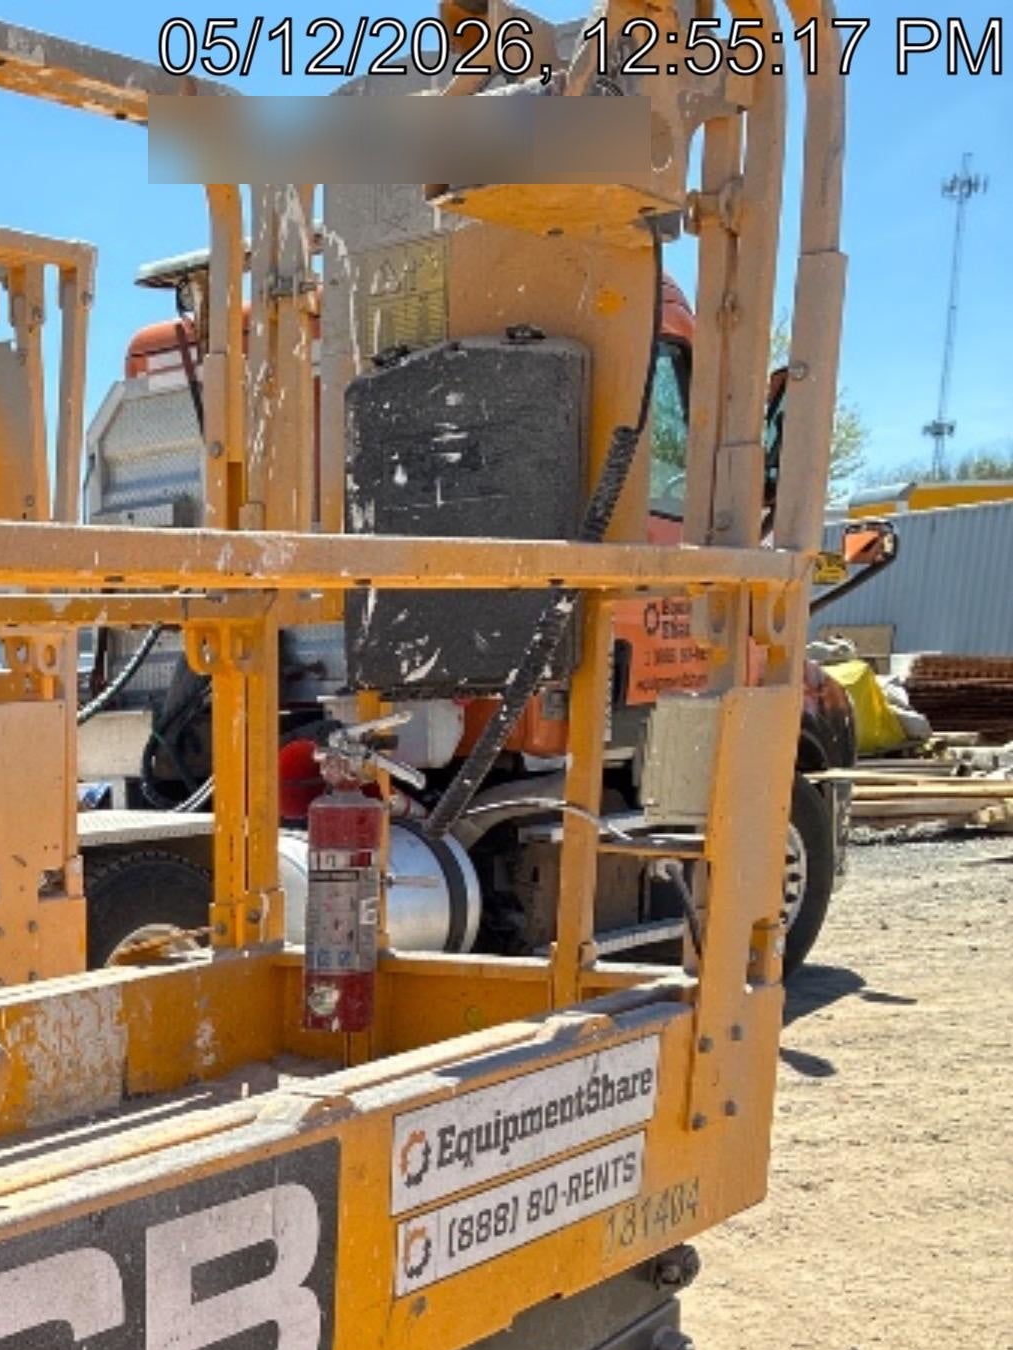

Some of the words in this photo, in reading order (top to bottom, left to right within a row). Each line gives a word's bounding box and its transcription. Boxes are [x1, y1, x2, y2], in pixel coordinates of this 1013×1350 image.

[437, 1067, 653, 1169] EquipmentShare
[448, 1196, 519, 1258] (888)
[527, 1152, 636, 1222] 80-RENTS
